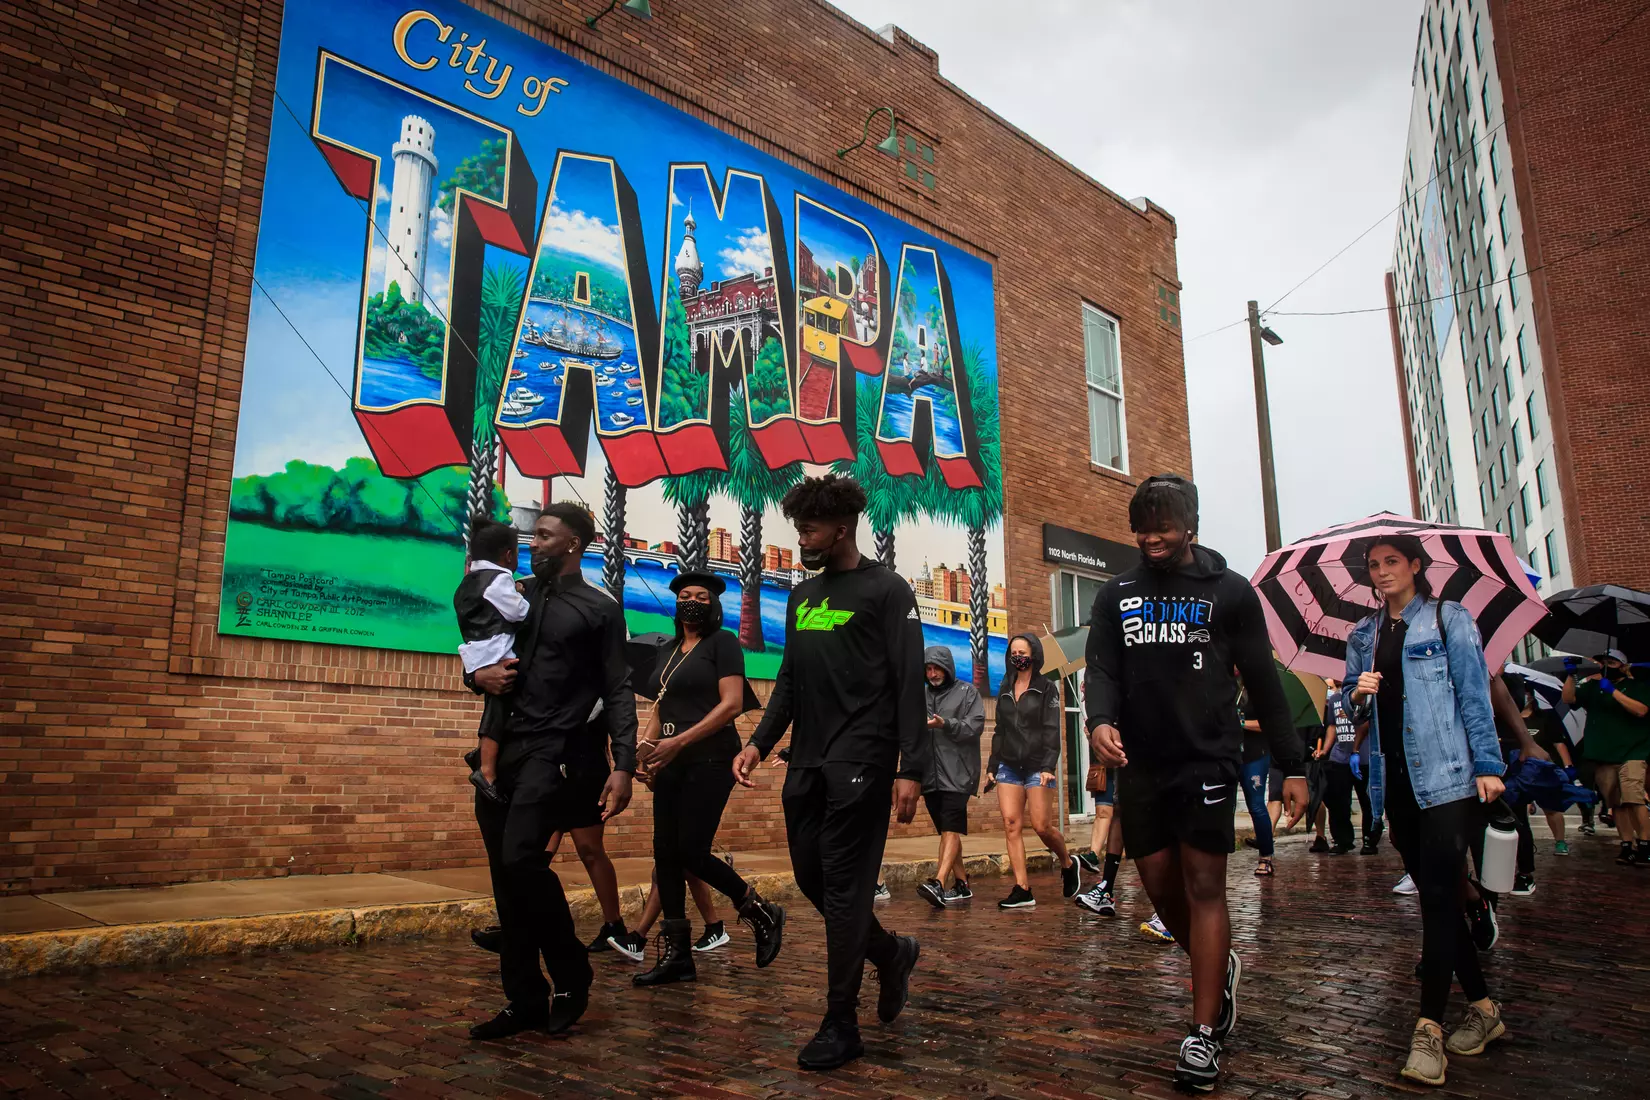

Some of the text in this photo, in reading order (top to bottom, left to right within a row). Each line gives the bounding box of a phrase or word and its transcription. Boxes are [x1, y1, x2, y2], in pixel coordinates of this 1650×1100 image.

[394, 10, 569, 117] City of
[311, 48, 970, 465] TAMPA
[1048, 547, 1107, 568] 1102 North Florida Ave
[260, 585, 278, 598] City
[280, 587, 289, 597] of
[319, 592, 341, 602] Public
[342, 594, 356, 604] Art
[356, 596, 387, 607] Program
[256, 598, 284, 611] CARL
[344, 606, 366, 617] 2012
[796, 597, 855, 631] USF
[256, 620, 272, 628] CARL
[1193, 651, 1203, 670] 3
